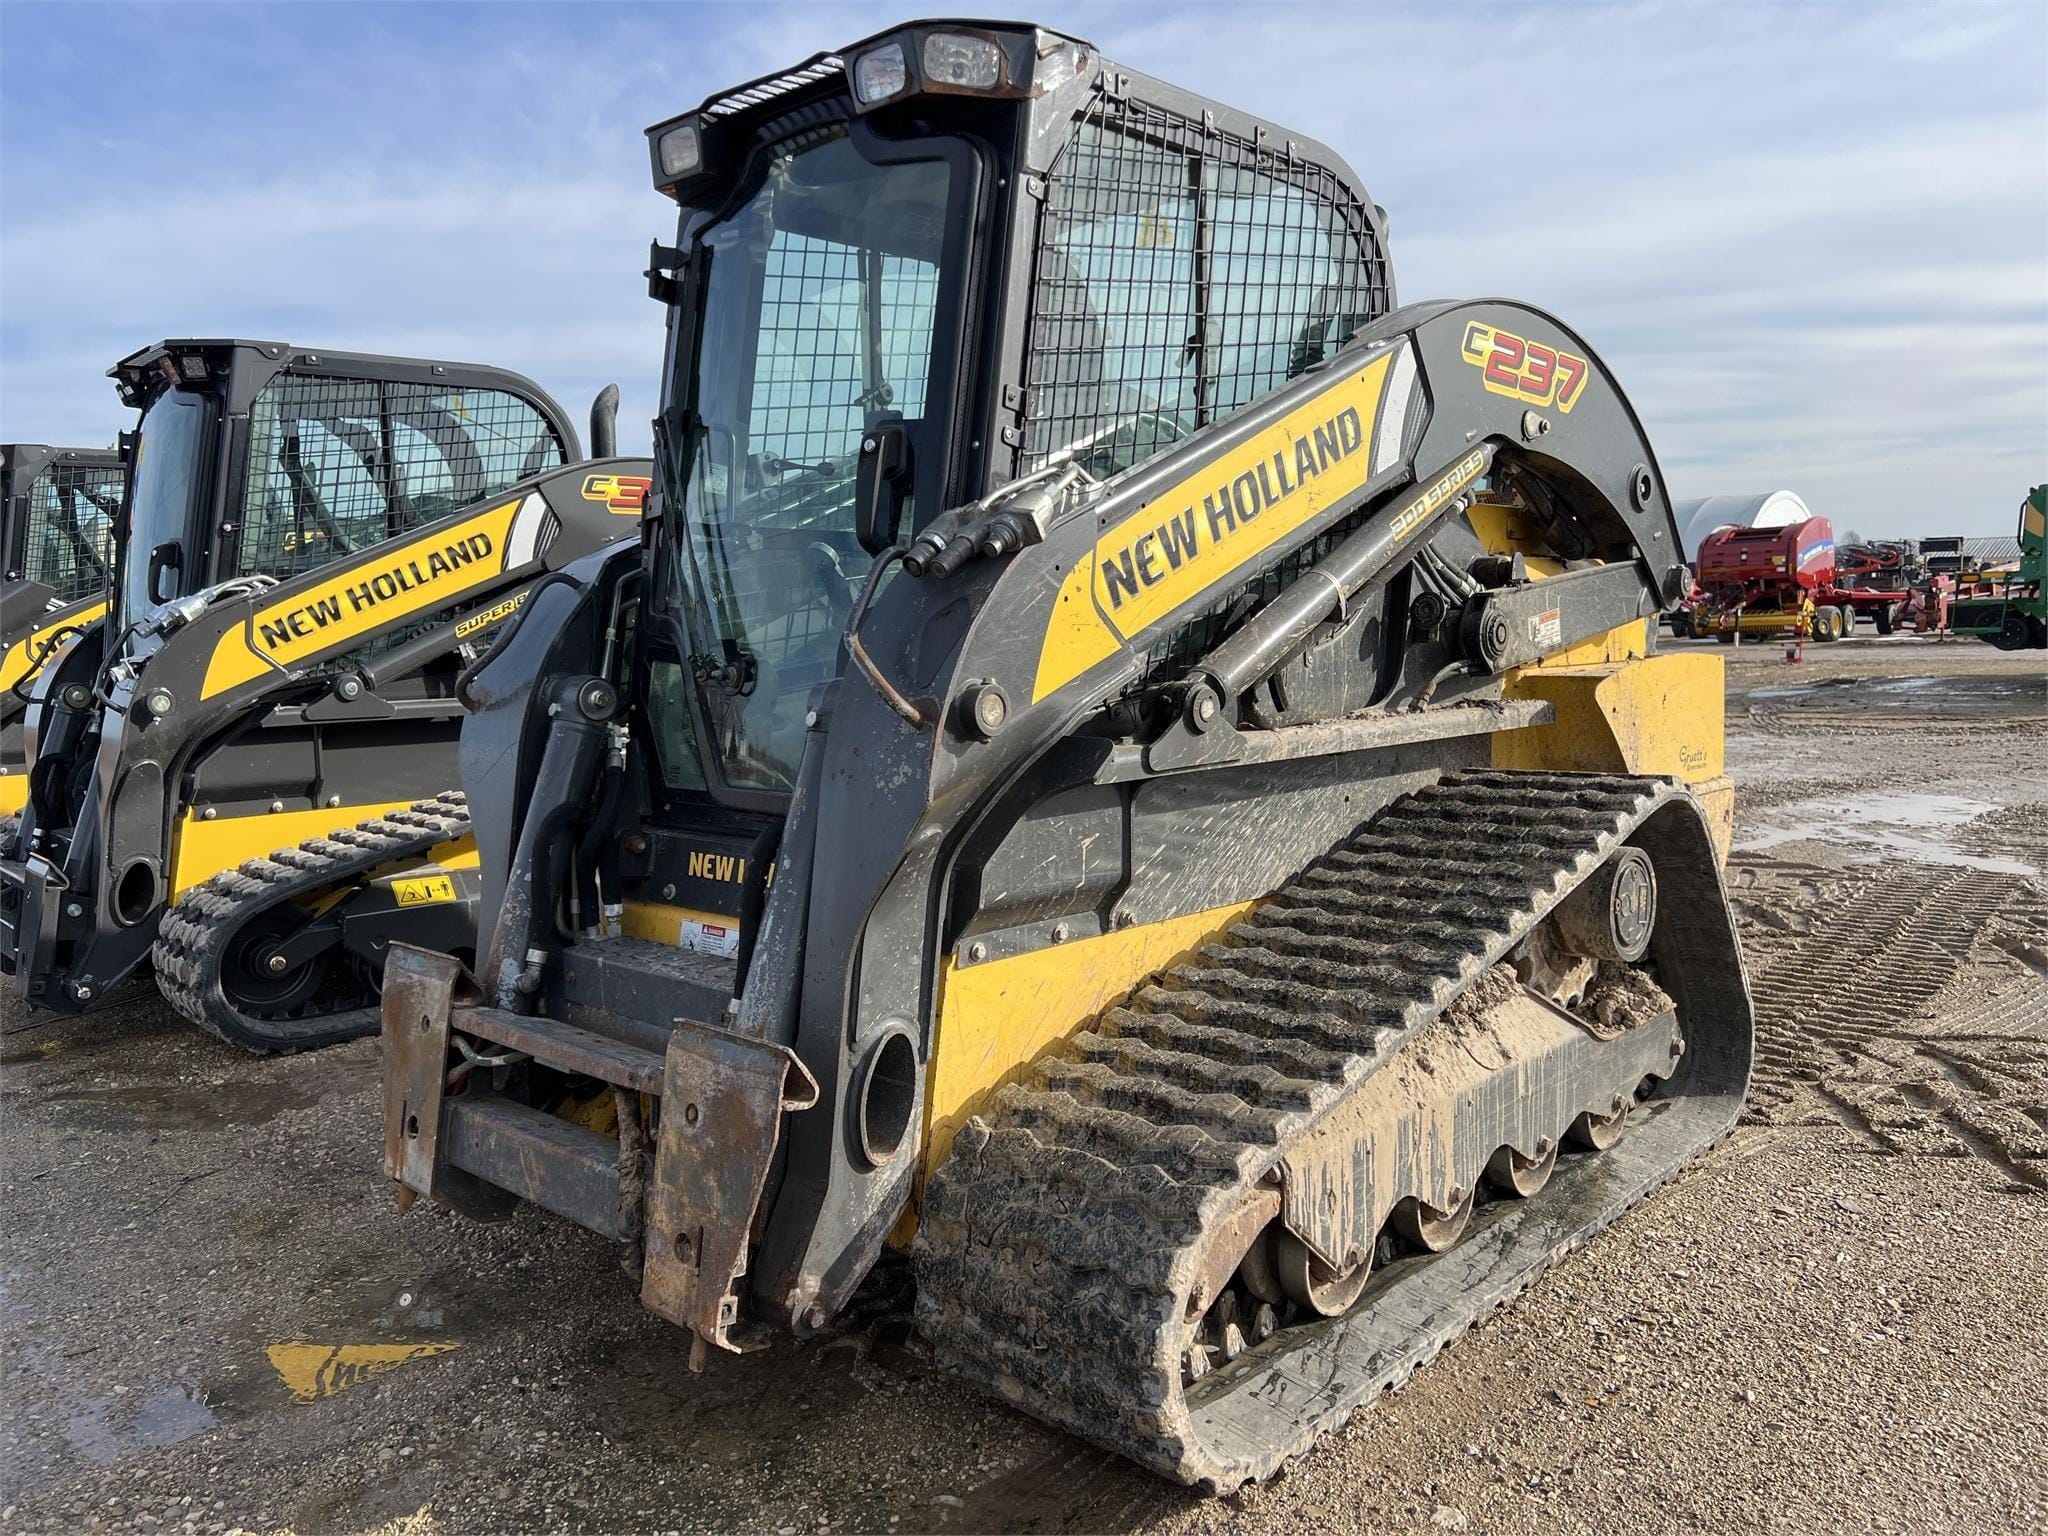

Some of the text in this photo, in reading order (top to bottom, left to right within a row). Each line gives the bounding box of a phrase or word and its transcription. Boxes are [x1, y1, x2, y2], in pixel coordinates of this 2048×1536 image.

[1462, 320, 1588, 413] C237
[1101, 405, 1363, 611] NEW HOLLAND
[1390, 450, 1484, 541] 200 SERIES
[259, 532, 494, 650] NEW HOLLAND
[455, 600, 516, 638] SUPER
[688, 851, 735, 882] NEW
